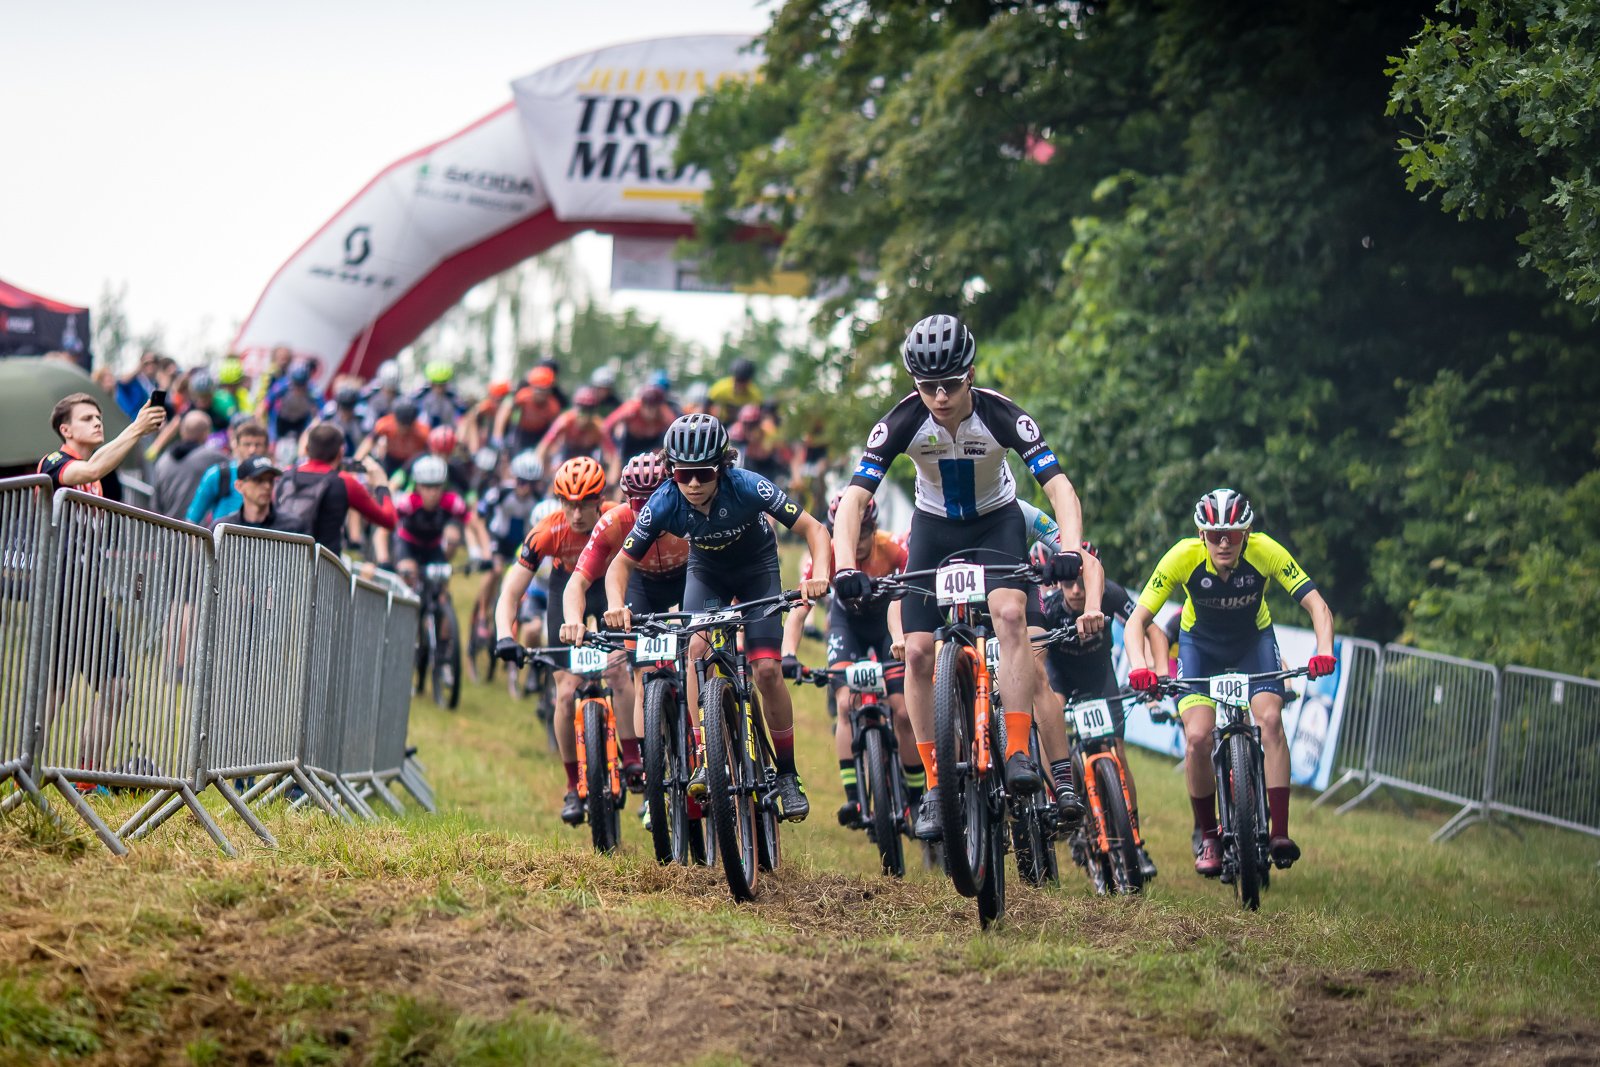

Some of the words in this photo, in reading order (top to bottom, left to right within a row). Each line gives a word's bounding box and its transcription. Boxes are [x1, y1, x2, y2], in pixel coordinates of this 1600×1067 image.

[574, 95, 681, 135] TRO
[566, 140, 709, 183] MAJ
[944, 570, 977, 594] 404
[644, 637, 669, 654] 401
[986, 642, 1000, 663] 40
[577, 650, 601, 665] 405
[853, 668, 877, 688] 409
[1082, 708, 1105, 729] 410
